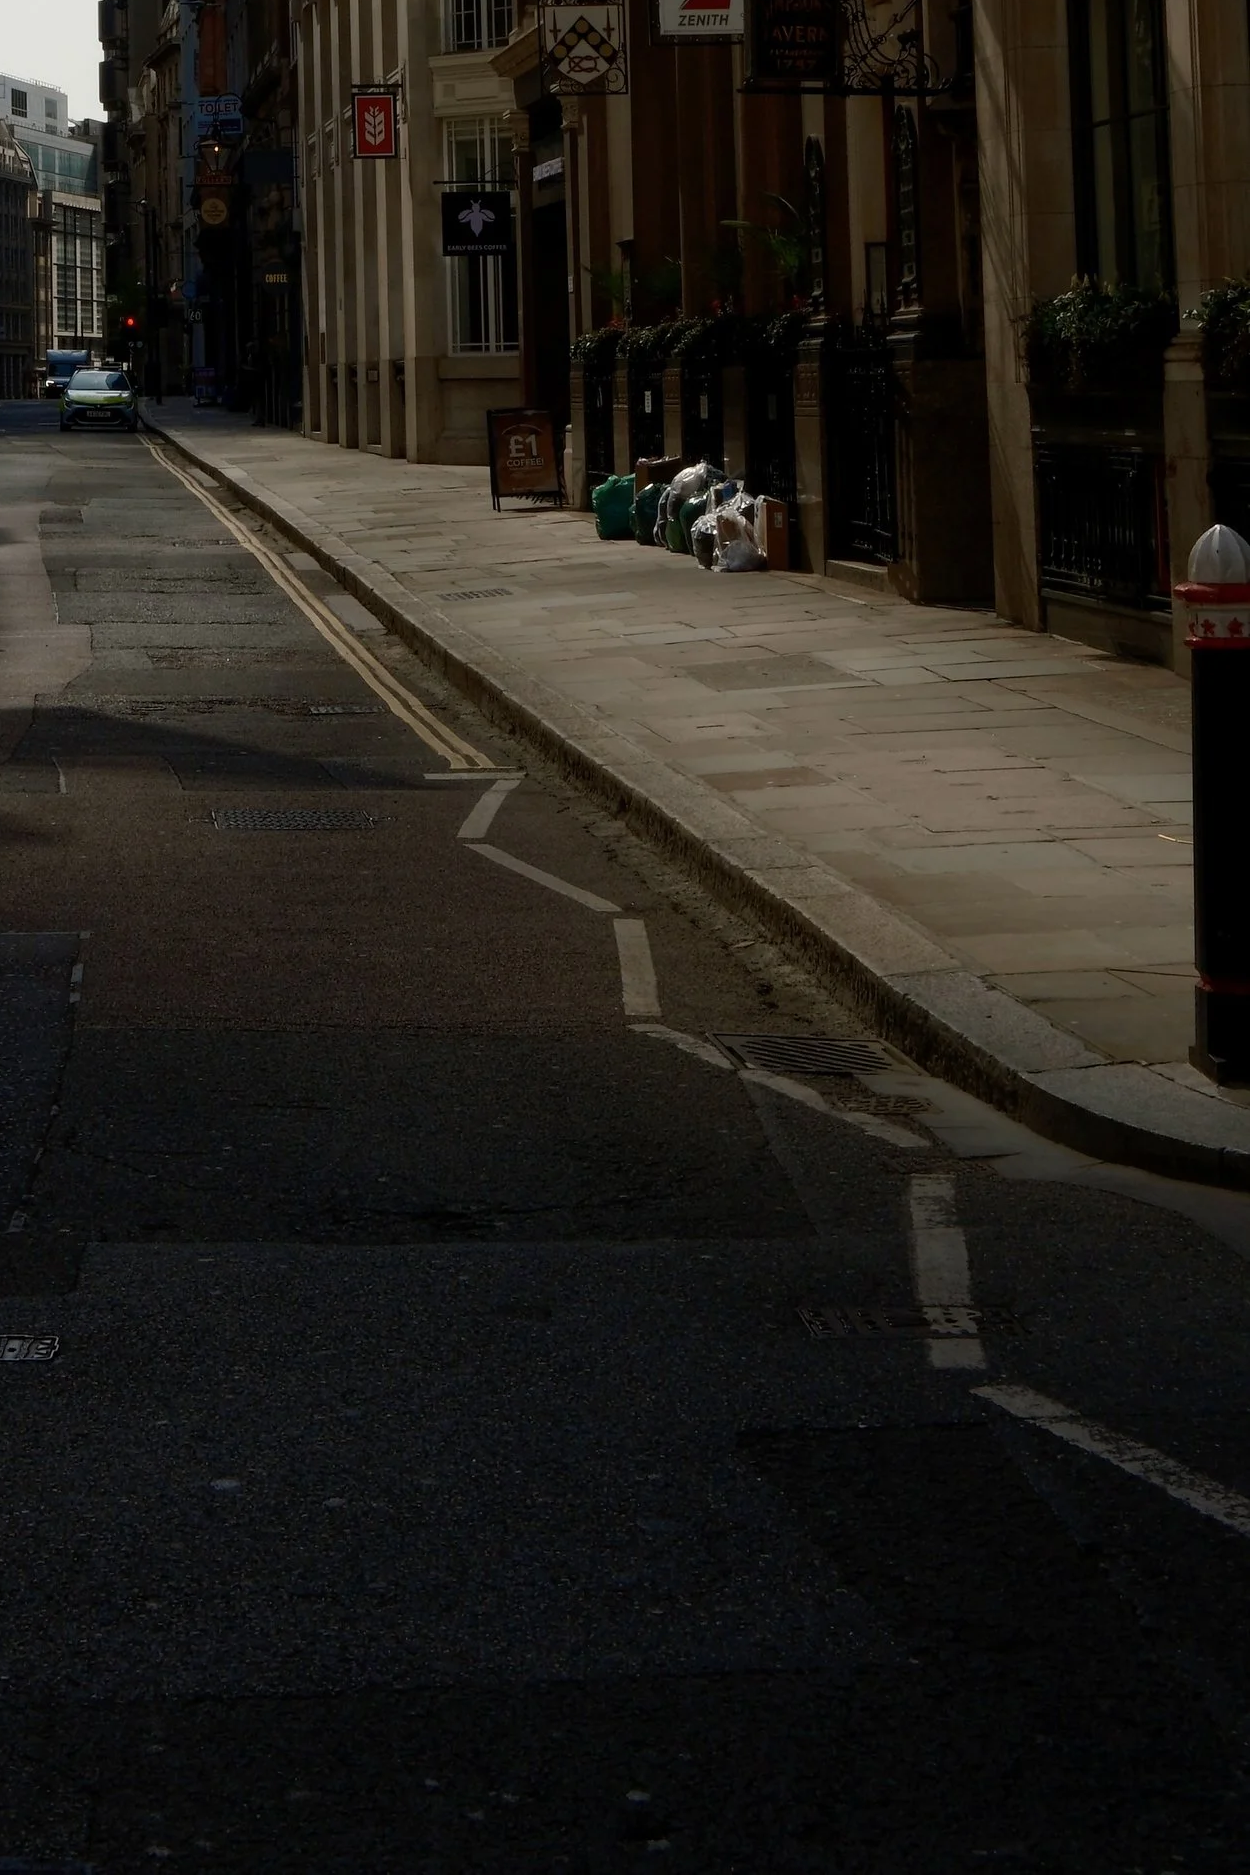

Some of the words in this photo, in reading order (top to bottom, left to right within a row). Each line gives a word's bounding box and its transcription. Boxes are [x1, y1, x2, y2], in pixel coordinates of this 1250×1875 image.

[678, 14, 729, 26] ZENITH
[217, 102, 238, 113] LET
[447, 244, 466, 252] EARLY
[265, 273, 288, 284] COFFEE
[508, 433, 538, 458] £1
